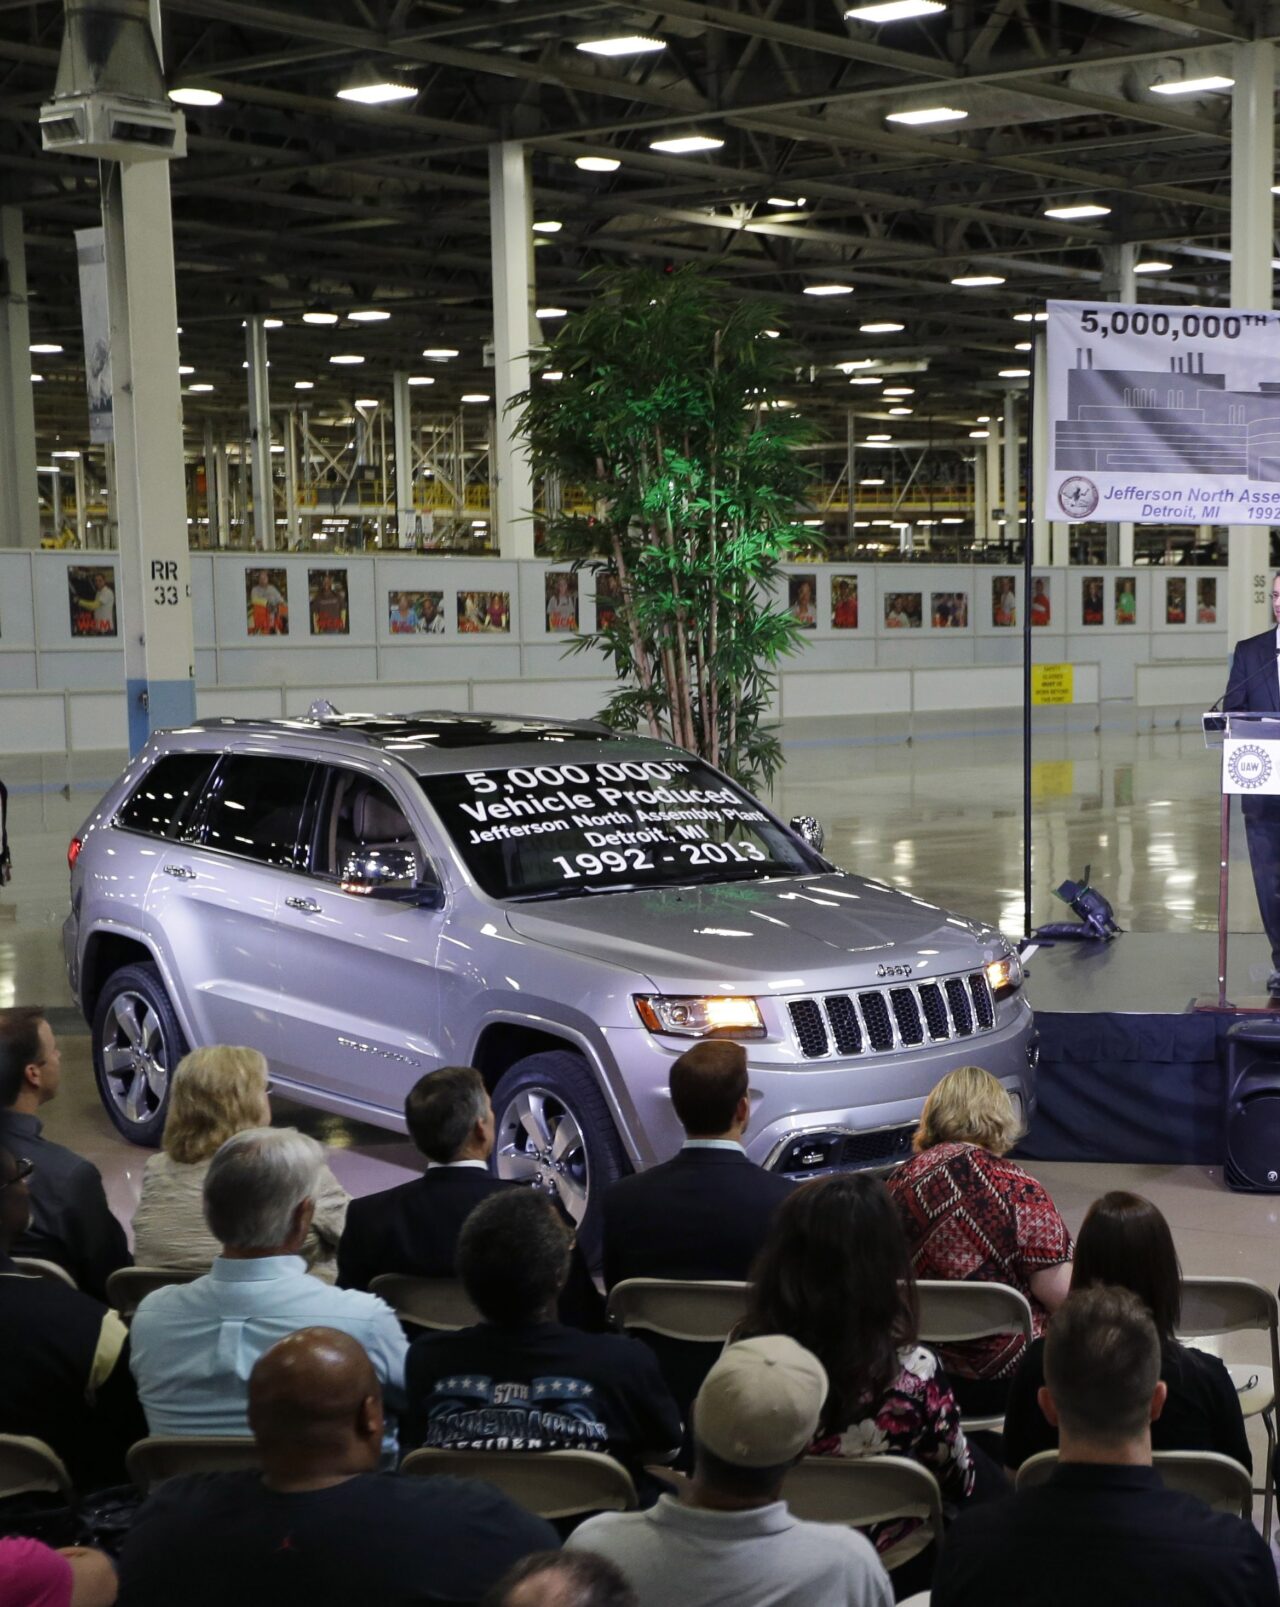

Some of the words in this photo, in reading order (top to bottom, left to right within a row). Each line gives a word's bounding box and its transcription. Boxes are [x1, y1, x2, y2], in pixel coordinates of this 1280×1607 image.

[1104, 486, 1183, 501] Jefferson
[1187, 488, 1234, 503] North
[1141, 504, 1197, 519] Detroit,
[1201, 506, 1221, 519] MI
[151, 561, 178, 580] RR
[154, 586, 178, 605] 33
[1241, 762, 1260, 772] UAW
[459, 791, 596, 822] Vehicle
[597, 786, 743, 806] Produced
[469, 817, 570, 845] Jefferson
[571, 811, 633, 829] North
[636, 808, 722, 823] Assembly
[721, 808, 770, 823] Plant
[583, 826, 677, 848] Detroit,
[678, 824, 710, 840] MI
[552, 848, 655, 879] 1992
[680, 841, 766, 865] 2013
[876, 963, 913, 978] Jeep
